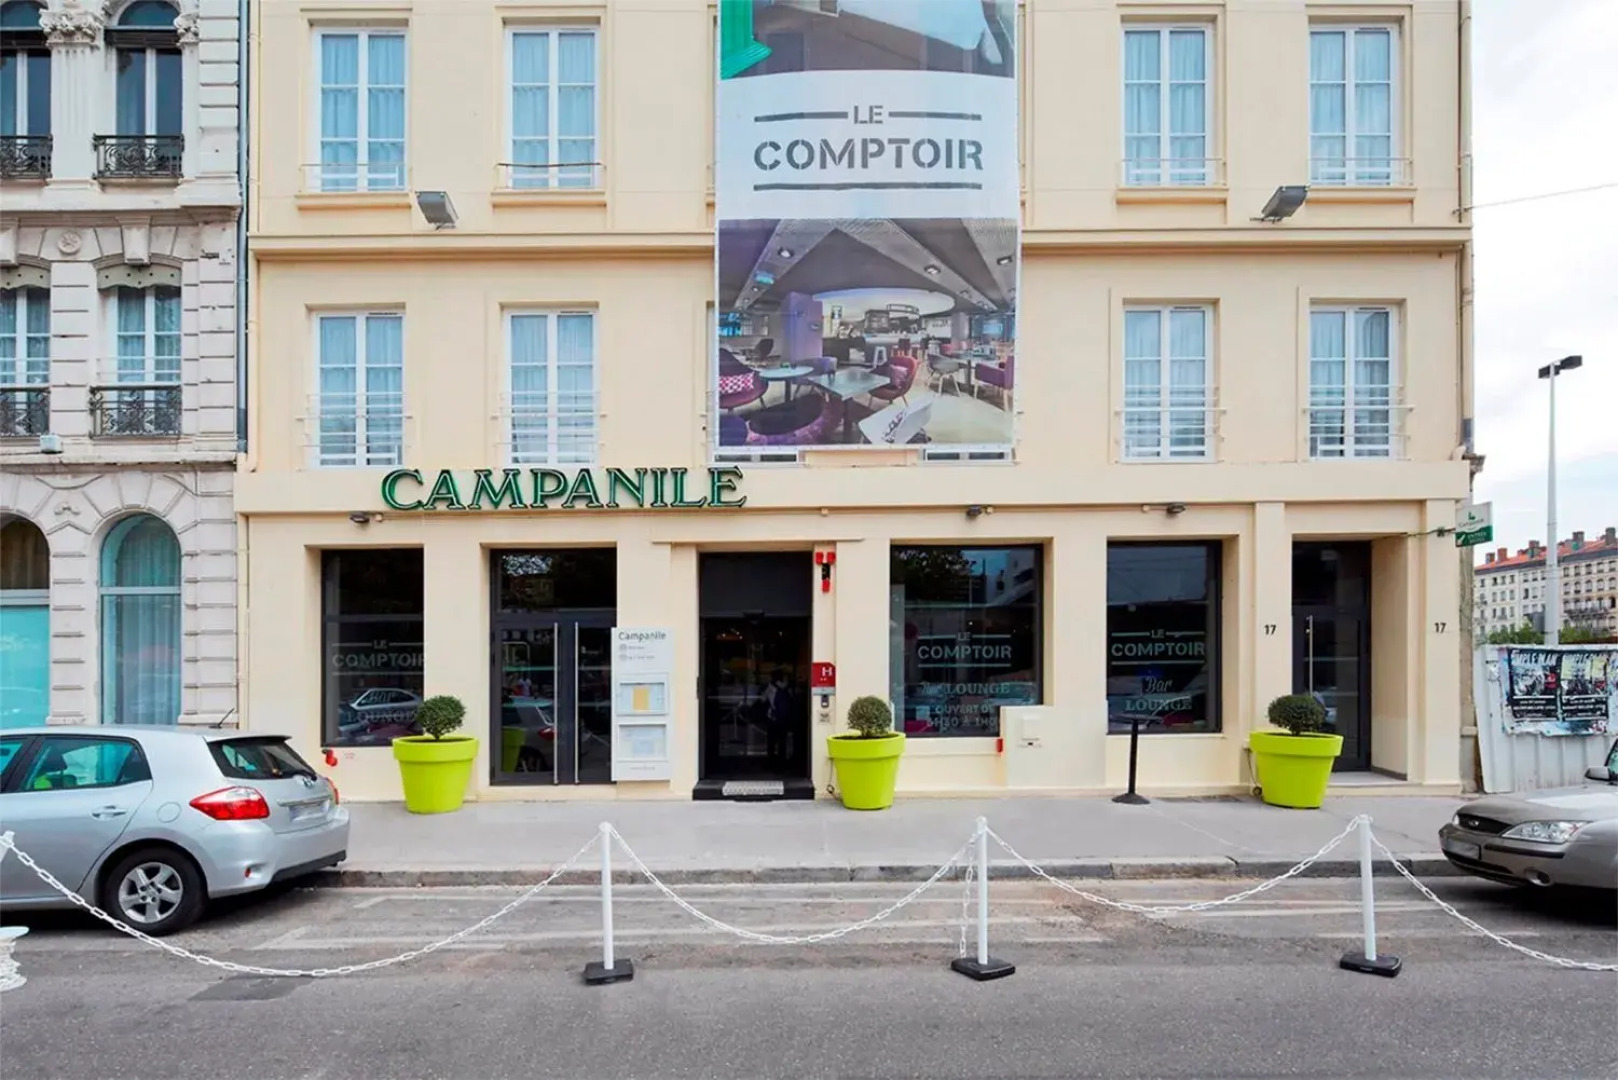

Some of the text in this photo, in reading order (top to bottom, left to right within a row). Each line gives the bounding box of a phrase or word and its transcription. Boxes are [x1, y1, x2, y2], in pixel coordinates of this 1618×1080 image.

[853, 105, 884, 125] LE
[753, 137, 984, 171] COMPTOIR
[381, 465, 748, 511] CAMPANILE
[1151, 629, 1165, 639] LE
[1264, 624, 1277, 636] 17
[1434, 622, 1447, 634] 17
[618, 631, 667, 643] Campanile
[956, 631, 971, 641] LE
[373, 639, 388, 649] LE
[1111, 641, 1206, 657] COMPTOIR
[917, 645, 1012, 660] COMPTOIR
[821, 666, 833, 677] H
[945, 682, 1010, 695] LOUNGE
[1124, 698, 1192, 712] LOUNGE
